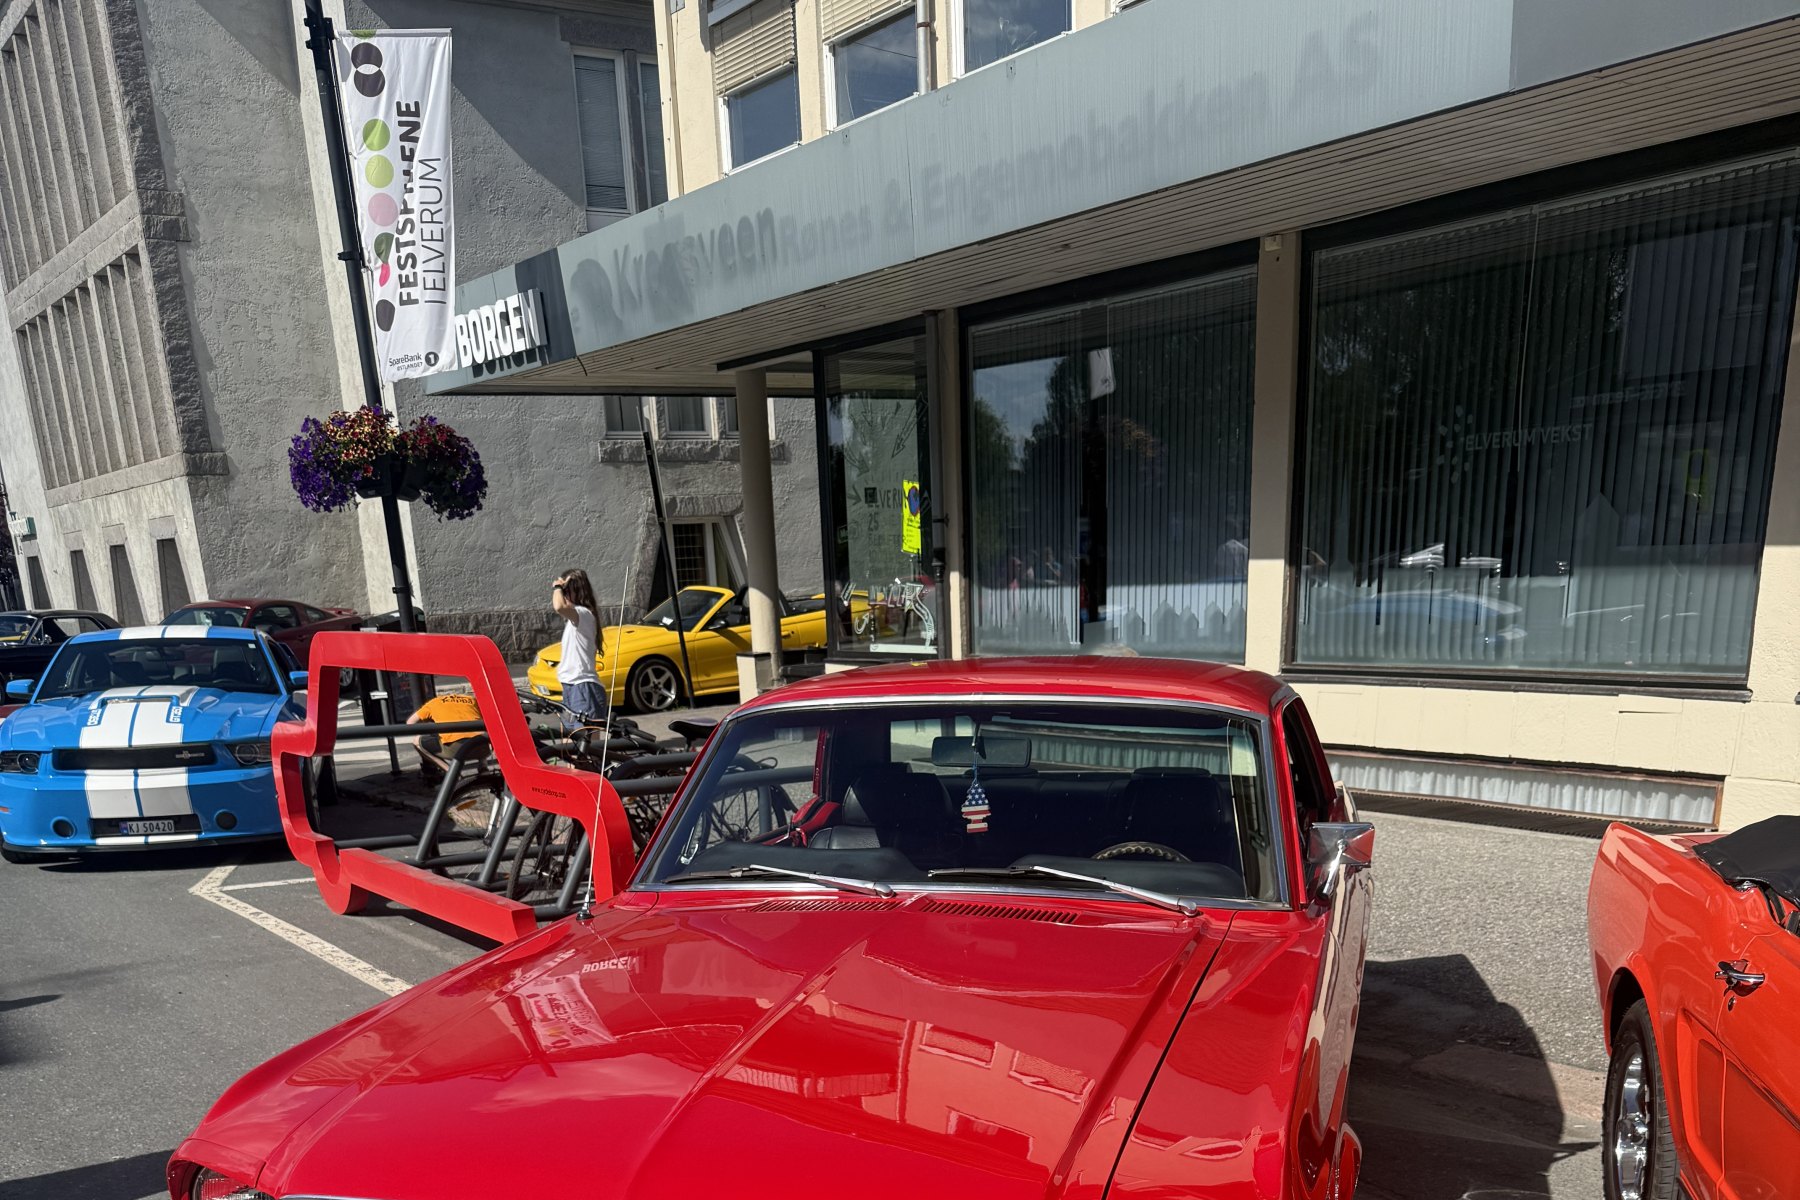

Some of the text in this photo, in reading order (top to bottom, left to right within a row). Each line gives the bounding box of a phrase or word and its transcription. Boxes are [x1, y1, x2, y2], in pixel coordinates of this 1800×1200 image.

[420, 157, 447, 293] ELVERUM
[455, 289, 541, 369] BORGEN
[389, 352, 422, 367] SpareBank
[1465, 423, 1593, 451] ELVERUM VEKST
[128, 822, 173, 834] KJ 50420
